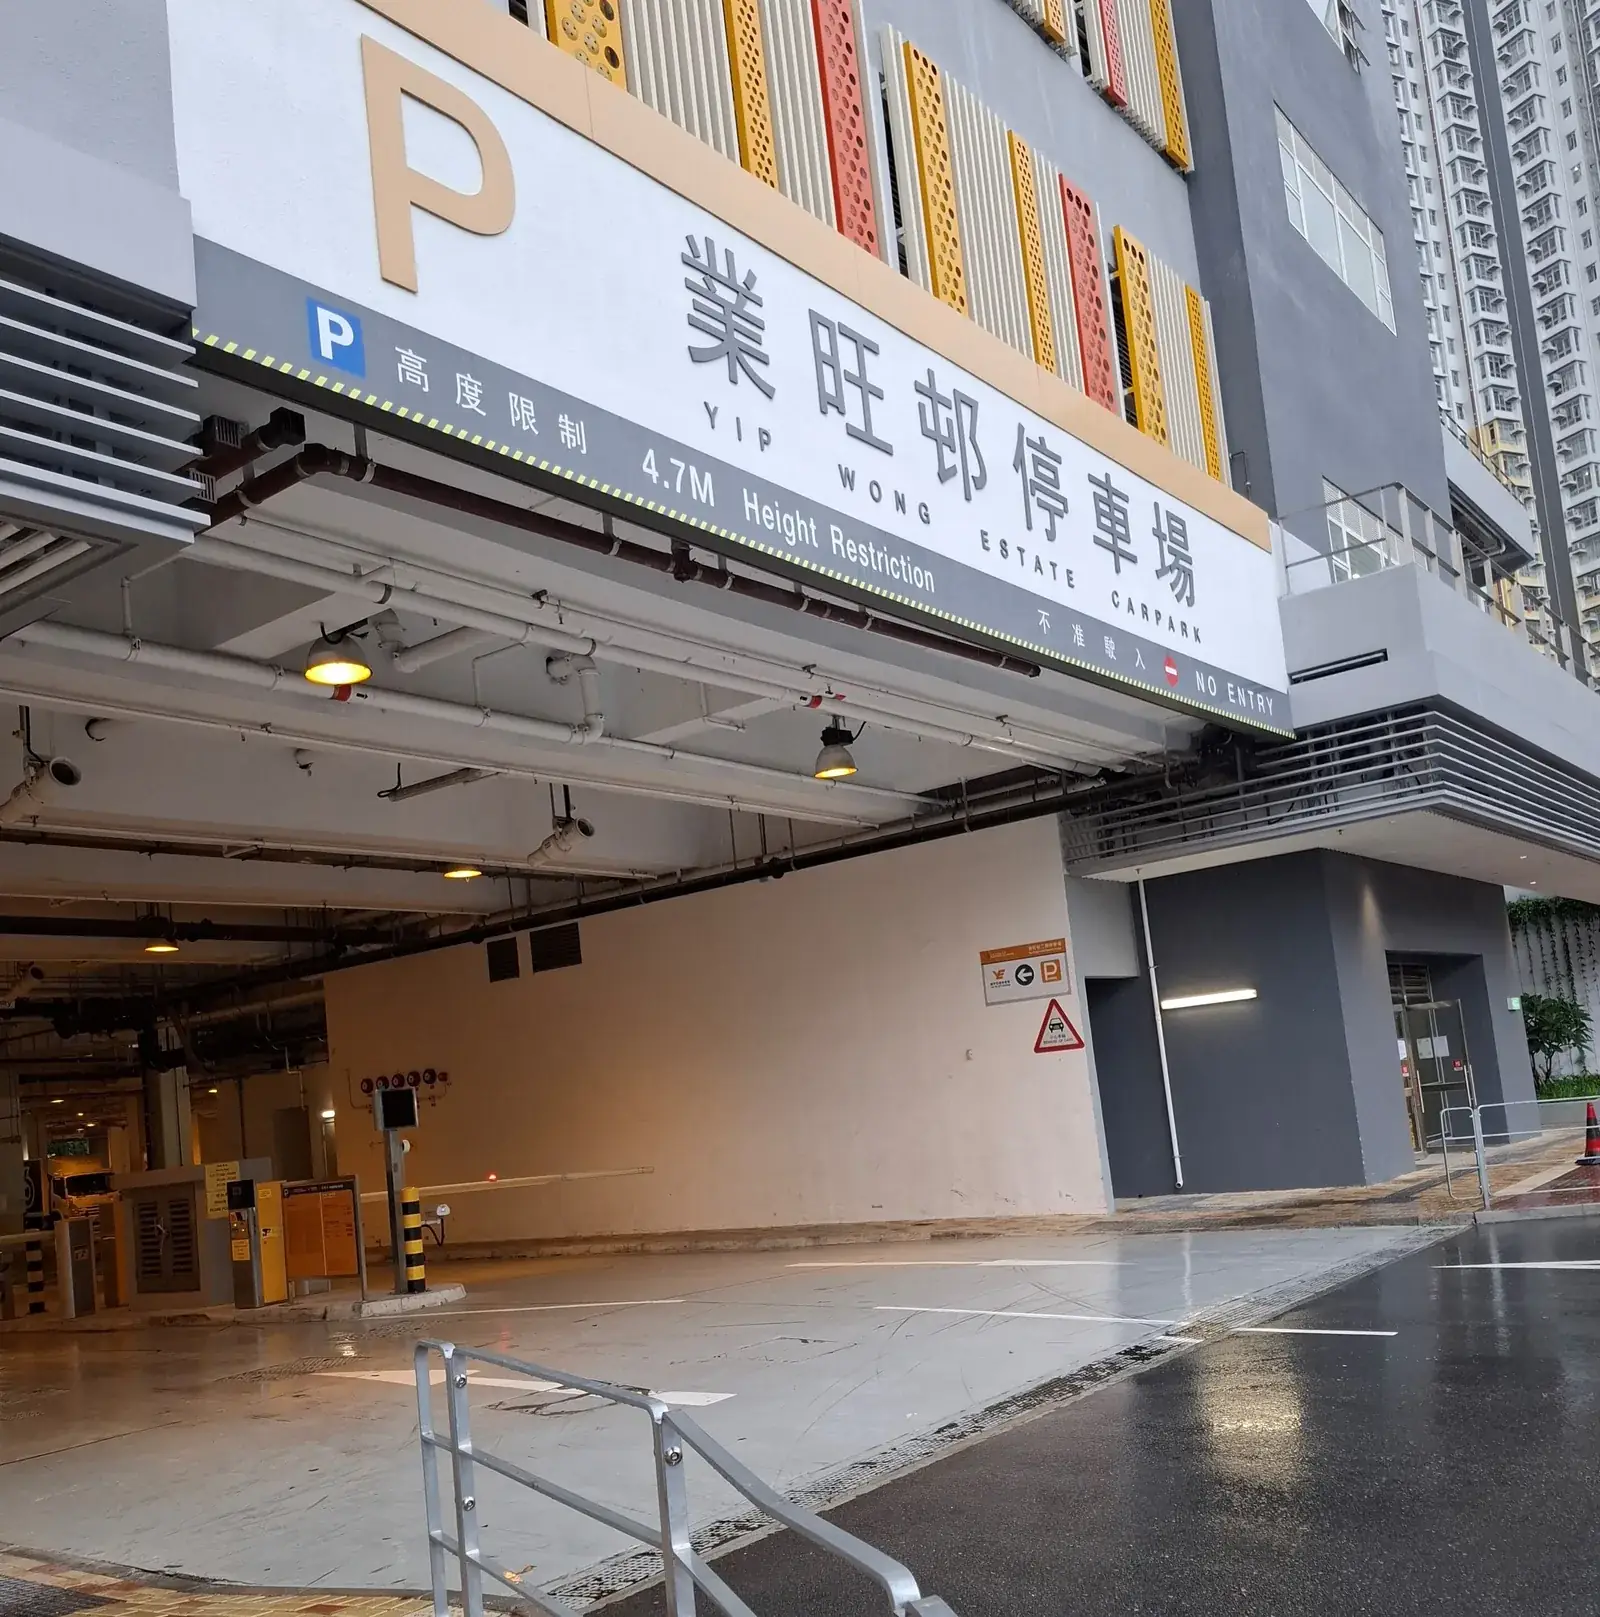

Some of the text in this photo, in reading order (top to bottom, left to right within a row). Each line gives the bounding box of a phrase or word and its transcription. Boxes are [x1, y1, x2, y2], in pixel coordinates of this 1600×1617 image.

[361, 33, 515, 294] P
[317, 306, 354, 360] P
[394, 346, 587, 454] 高度限制
[681, 234, 1196, 607] 業旺邨停車場
[641, 448, 935, 593] 4.7M Height Restriction
[703, 400, 1202, 644] YIP WONG ESTATE CARPARK
[1037, 609, 1146, 670] 不准駛入
[1195, 670, 1273, 716] NO ENTRY
